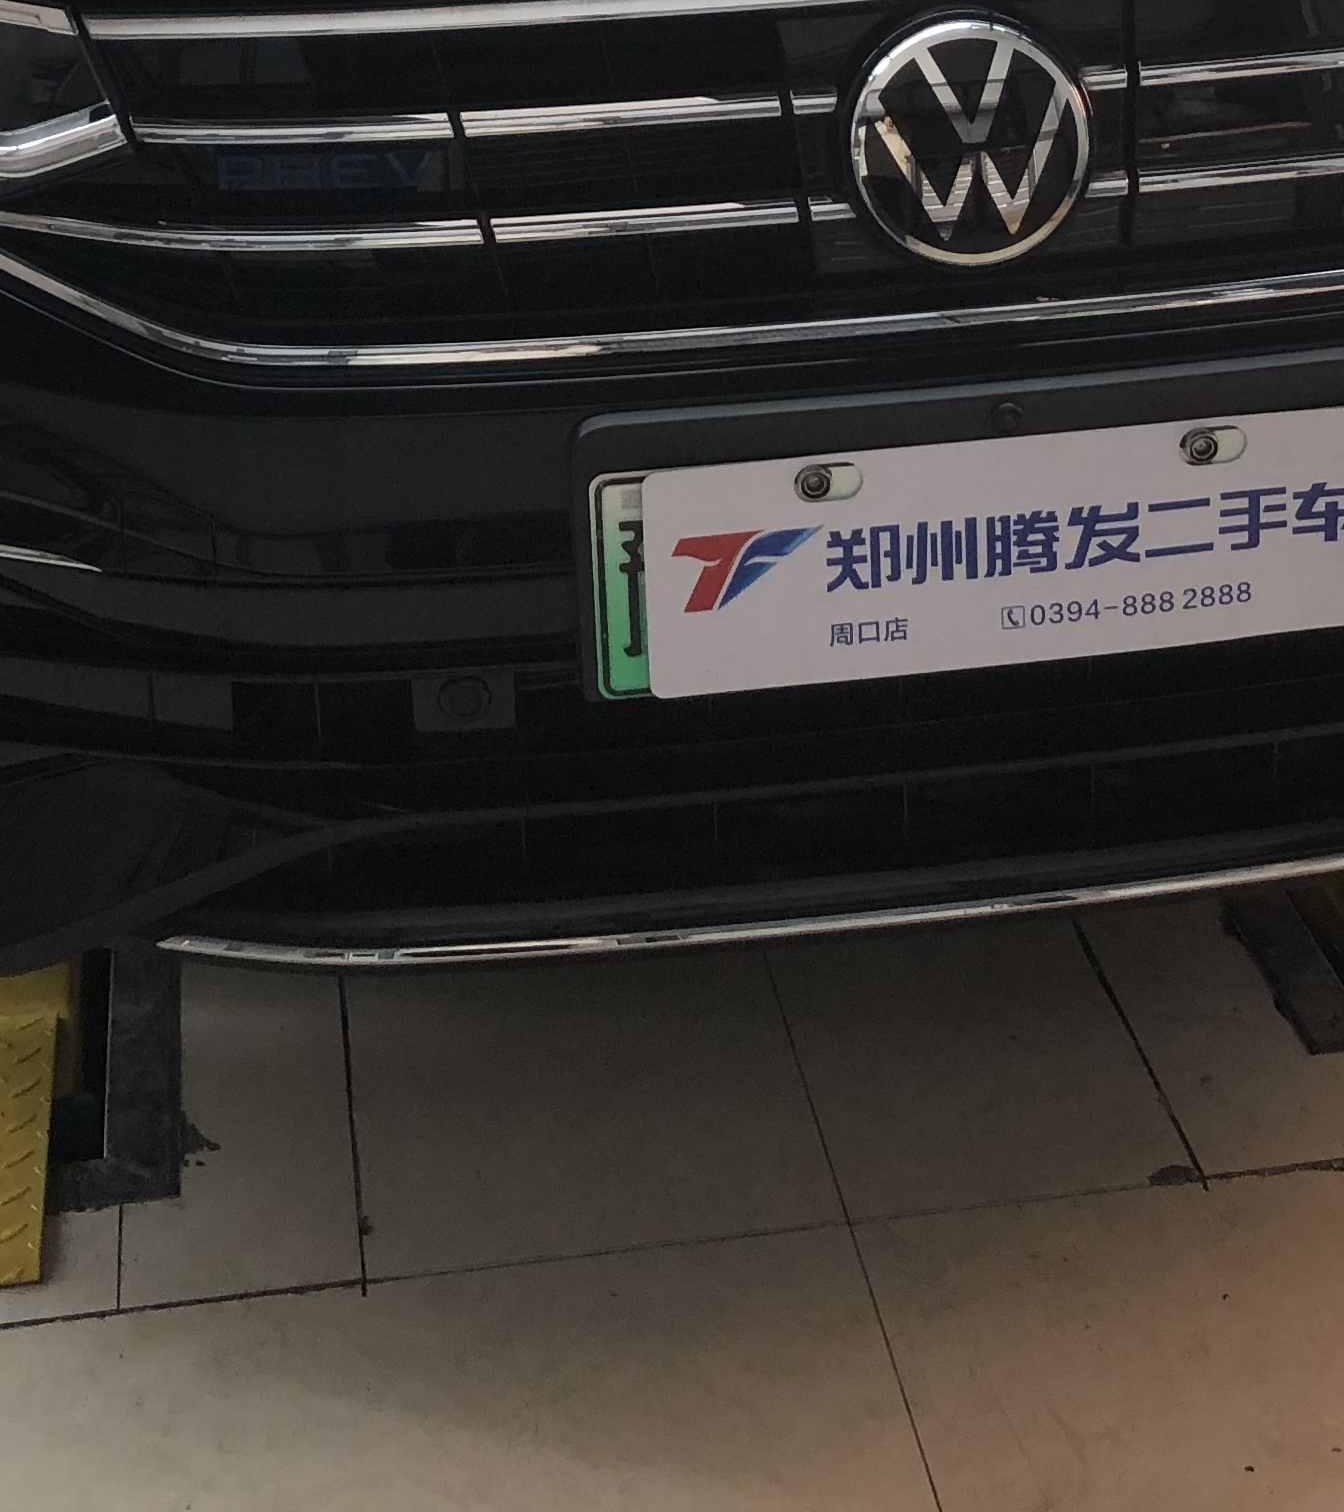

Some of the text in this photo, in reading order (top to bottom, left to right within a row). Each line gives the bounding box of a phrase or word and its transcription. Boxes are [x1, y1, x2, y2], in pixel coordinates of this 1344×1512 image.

[218, 151, 434, 190] PHEV
[830, 616, 909, 647] 周口店
